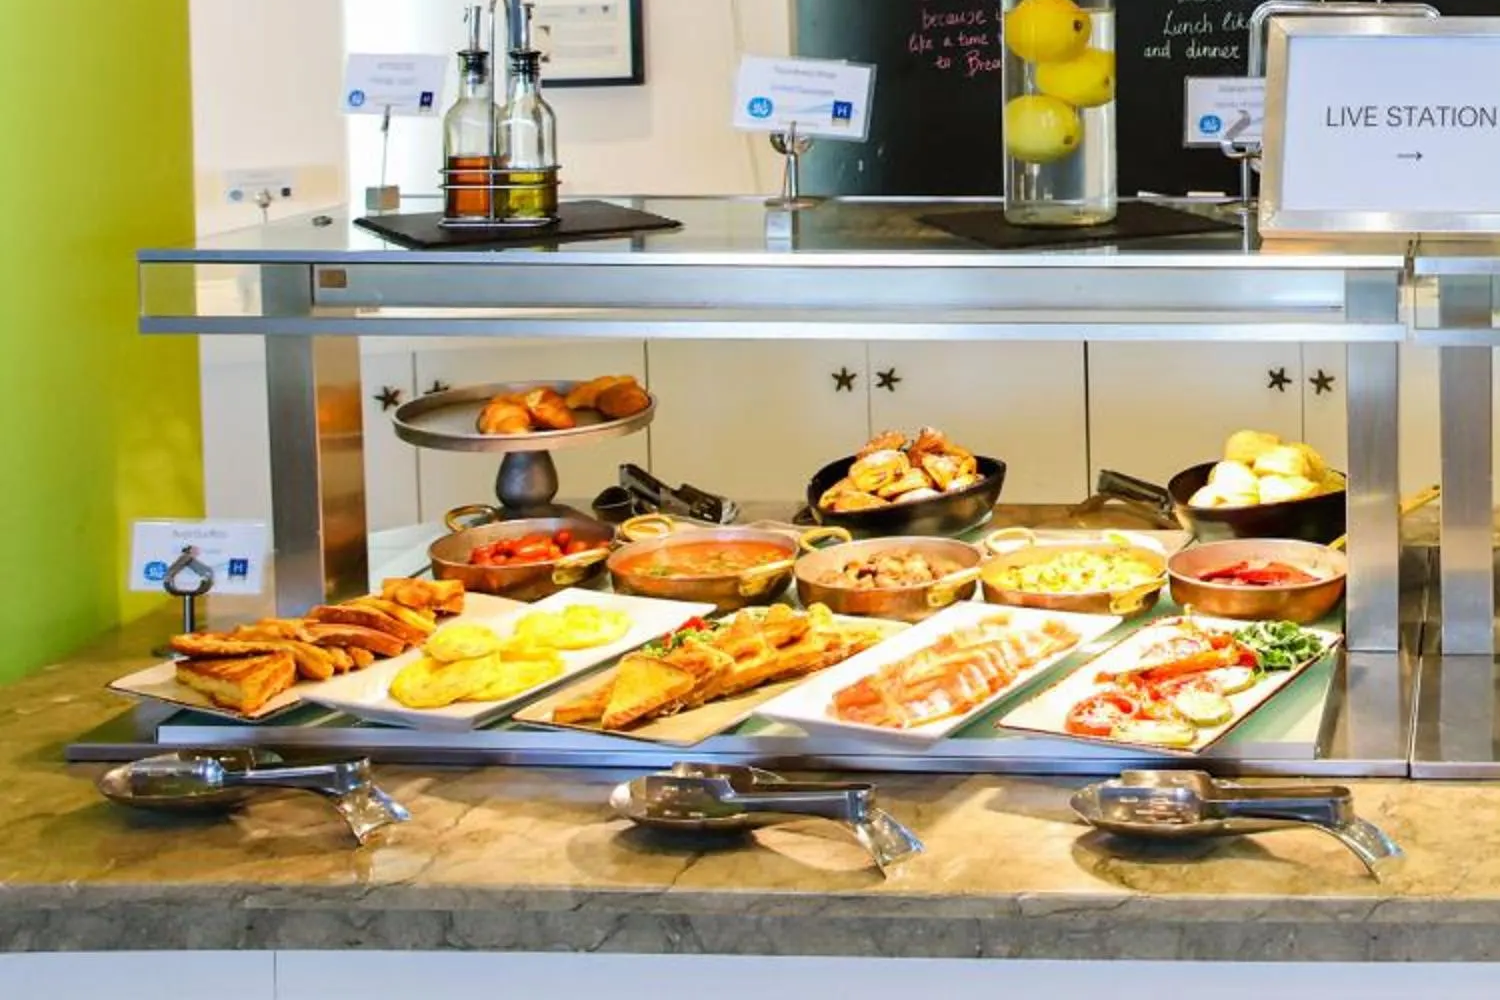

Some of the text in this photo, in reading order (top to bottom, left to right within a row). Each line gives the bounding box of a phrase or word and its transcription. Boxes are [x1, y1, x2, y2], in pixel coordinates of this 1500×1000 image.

[921, 8, 987, 28] because
[1163, 9, 1213, 36] Lunch
[944, 39, 952, 47] a
[958, 32, 989, 47] time
[1144, 37, 1240, 59] and dinner
[1326, 105, 1498, 127] LIVE STATION
